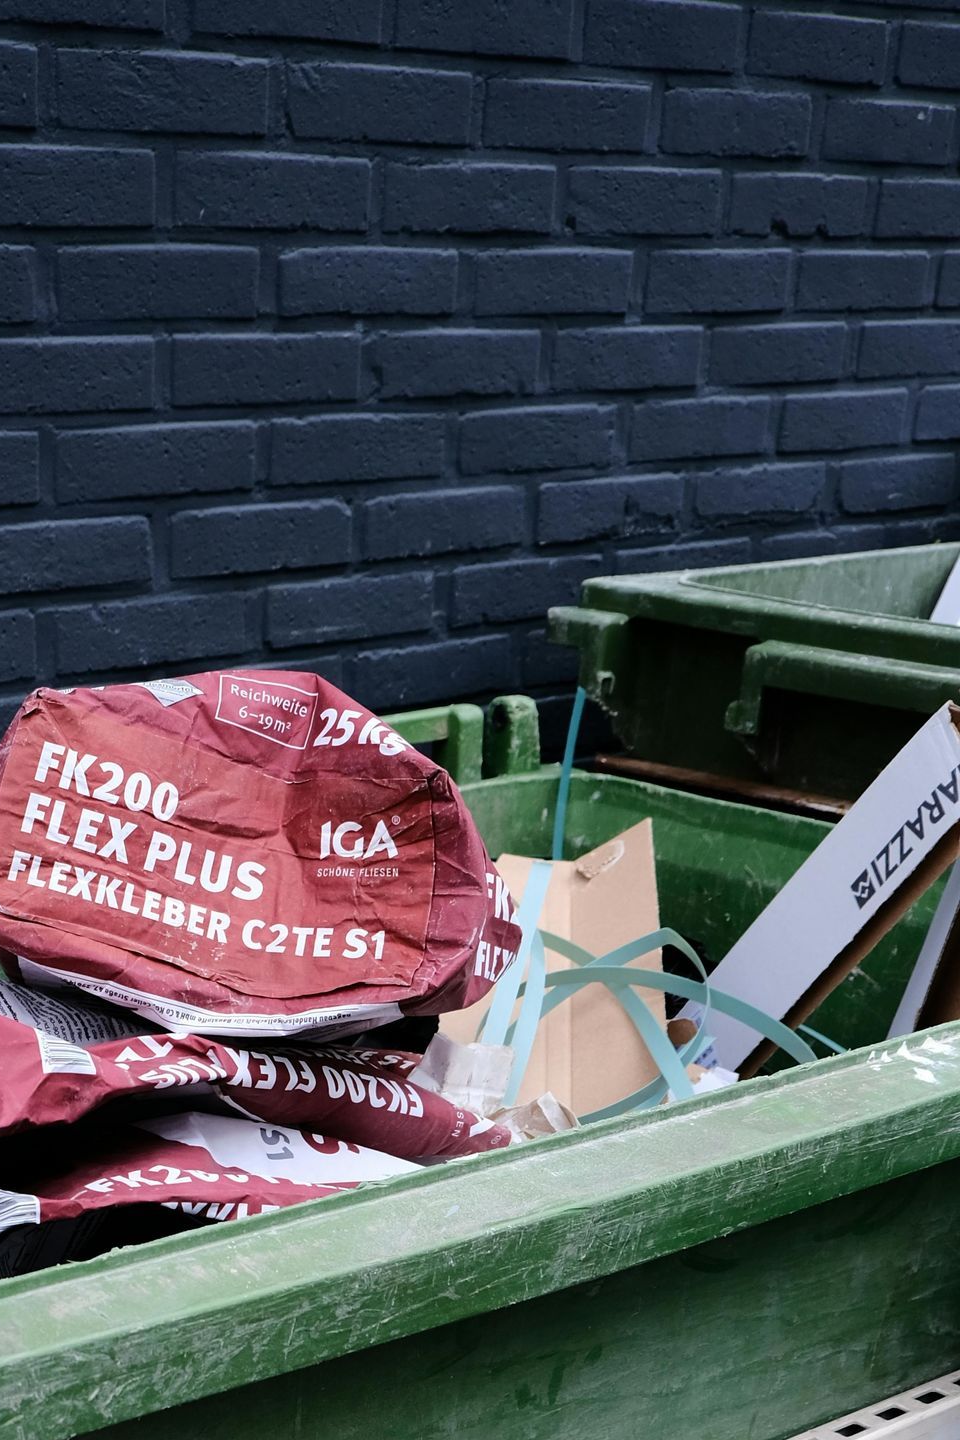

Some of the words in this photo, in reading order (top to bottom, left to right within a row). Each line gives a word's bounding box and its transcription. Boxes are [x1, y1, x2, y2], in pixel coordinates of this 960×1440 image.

[231, 683, 308, 718] Reichweite
[313, 708, 363, 747] 25
[34, 741, 179, 822] FK200
[20, 792, 138, 864] FLEX
[143, 830, 267, 901] PLUS
[870, 763, 960, 887] ARAZZI
[317, 866, 355, 877] SCHÖNE
[359, 867, 399, 877] FLIESEN
[7, 850, 231, 944] FLEXKLEBER
[241, 919, 334, 958] C2TE
[342, 928, 386, 960] S1
[222, 1046, 317, 1094] FLEX
[322, 1065, 424, 1118] FK200
